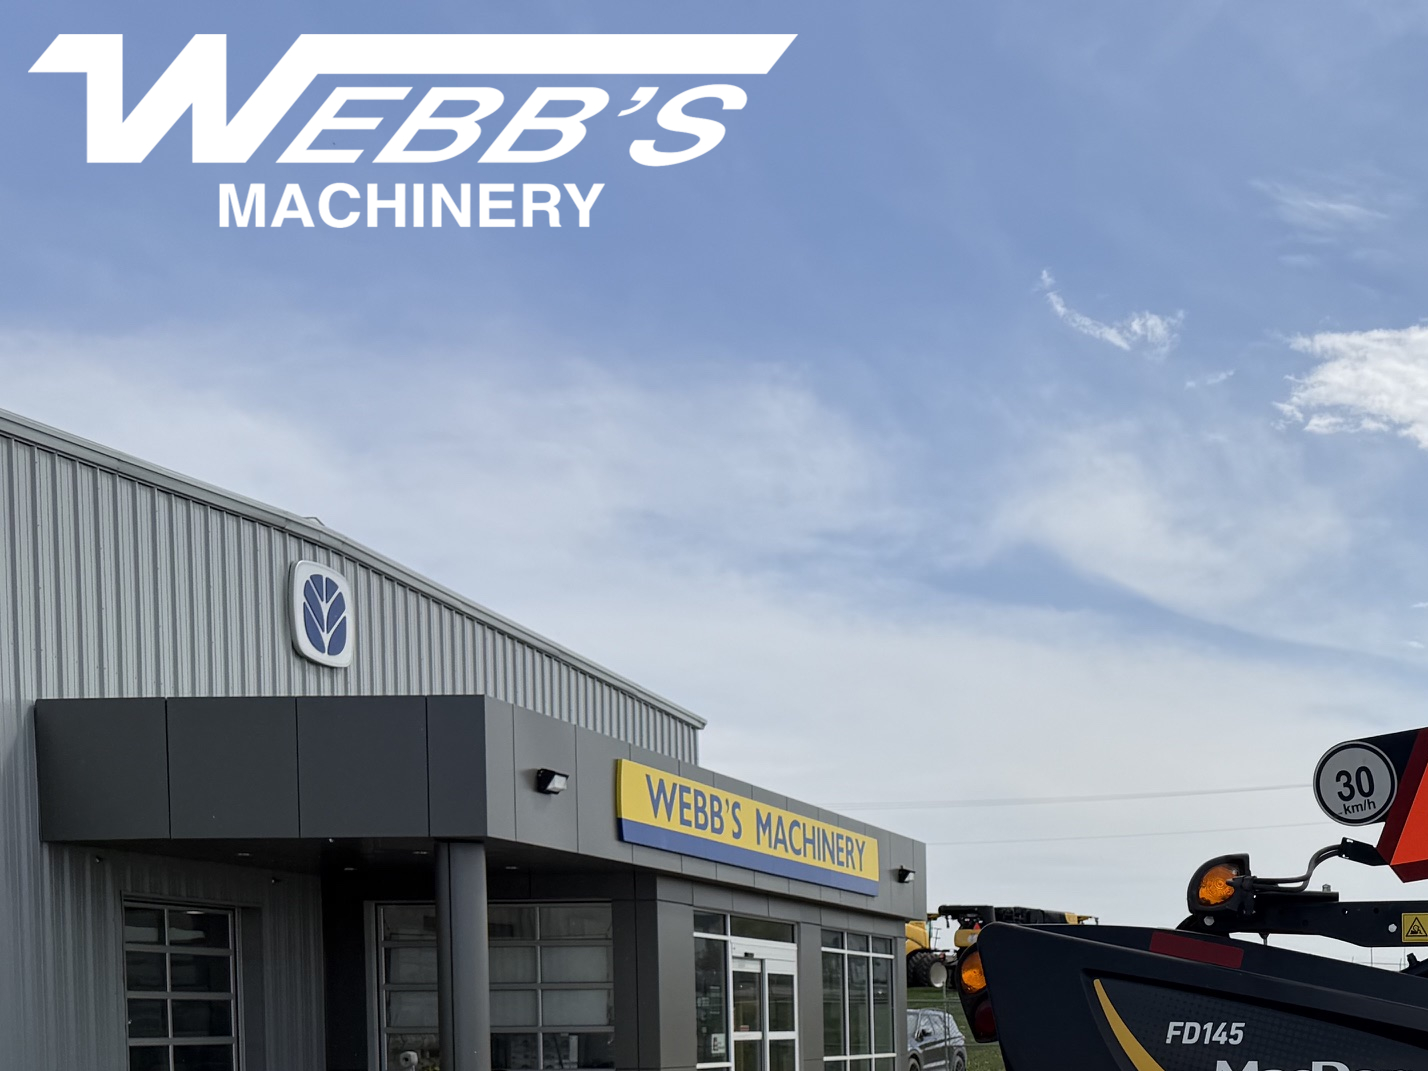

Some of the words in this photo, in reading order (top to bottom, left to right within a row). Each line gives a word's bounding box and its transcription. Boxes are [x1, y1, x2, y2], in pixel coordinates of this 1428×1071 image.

[1335, 765, 1375, 802] 30
[1342, 798, 1376, 815] km/h
[645, 774, 743, 840] WEBB'S
[756, 807, 866, 872] MACHINERY
[1165, 1021, 1246, 1045] FD145
